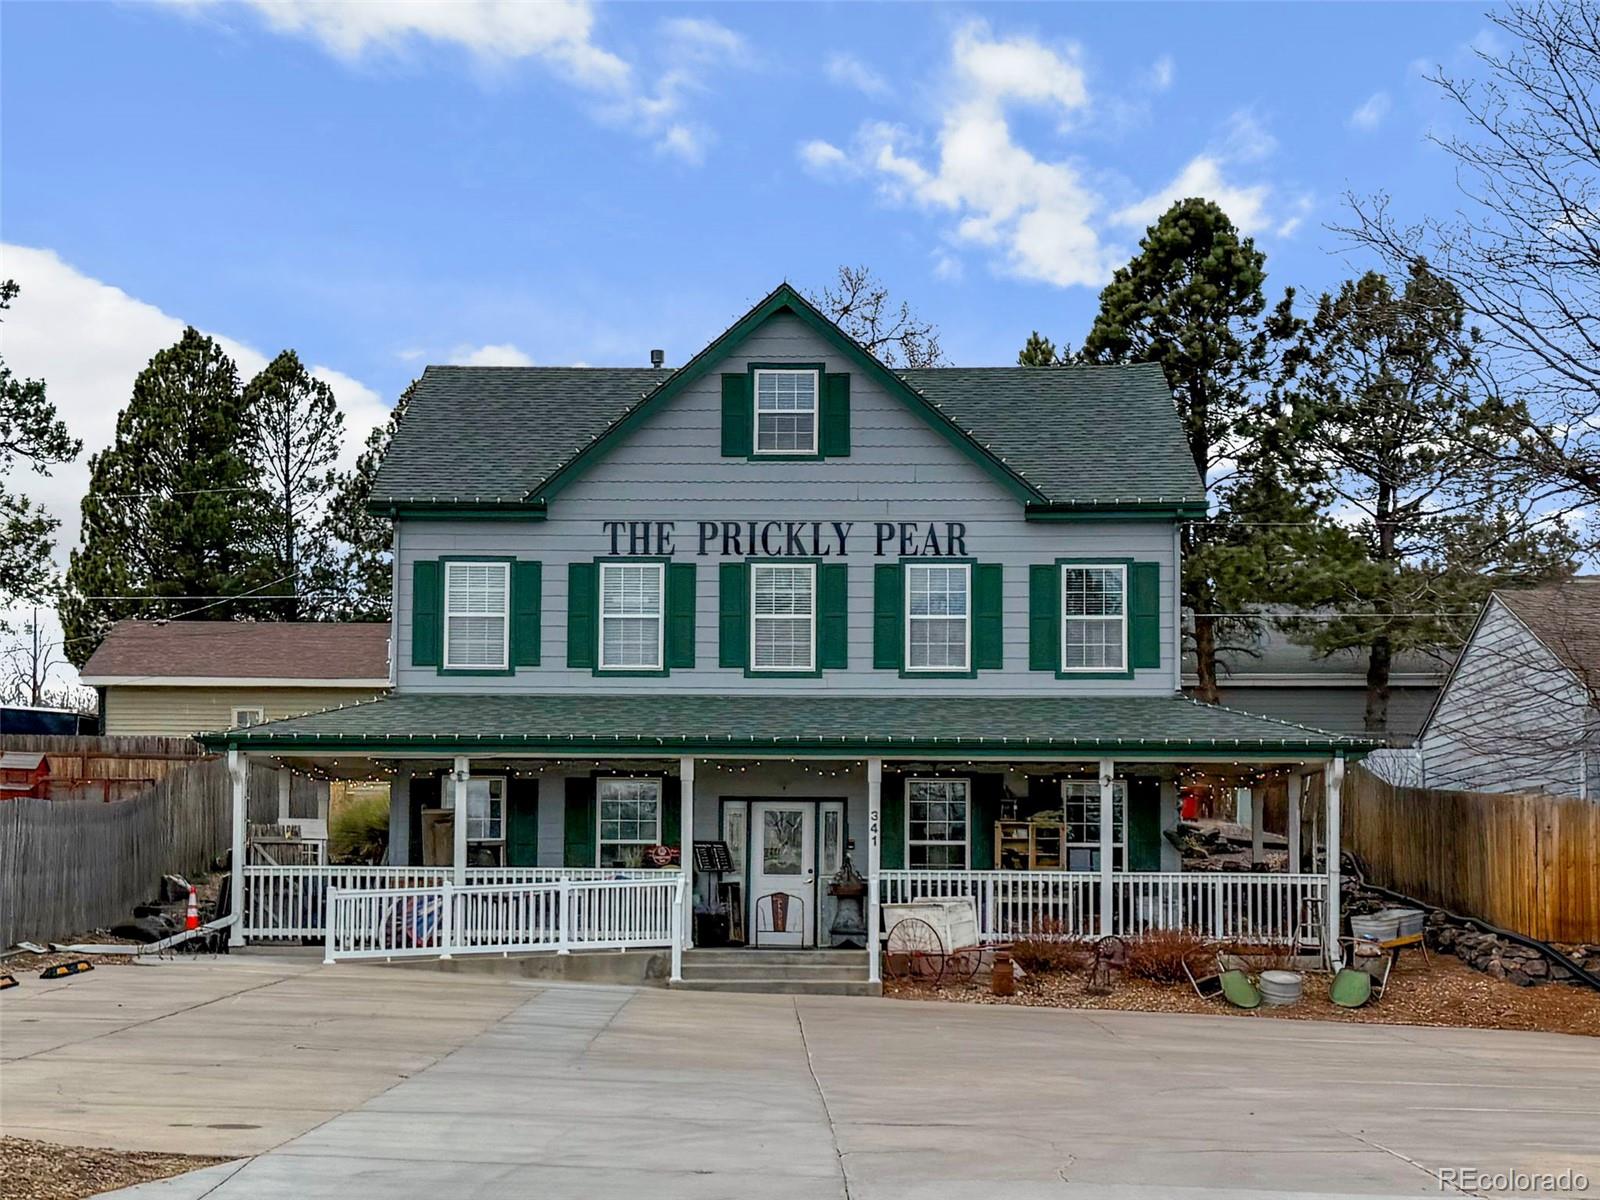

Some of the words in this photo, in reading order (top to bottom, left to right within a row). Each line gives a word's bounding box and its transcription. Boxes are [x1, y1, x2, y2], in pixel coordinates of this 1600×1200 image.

[603, 521, 676, 556] THE
[697, 521, 853, 557] PRICKLY
[873, 522, 969, 557] PEAR
[870, 810, 879, 847] 341
